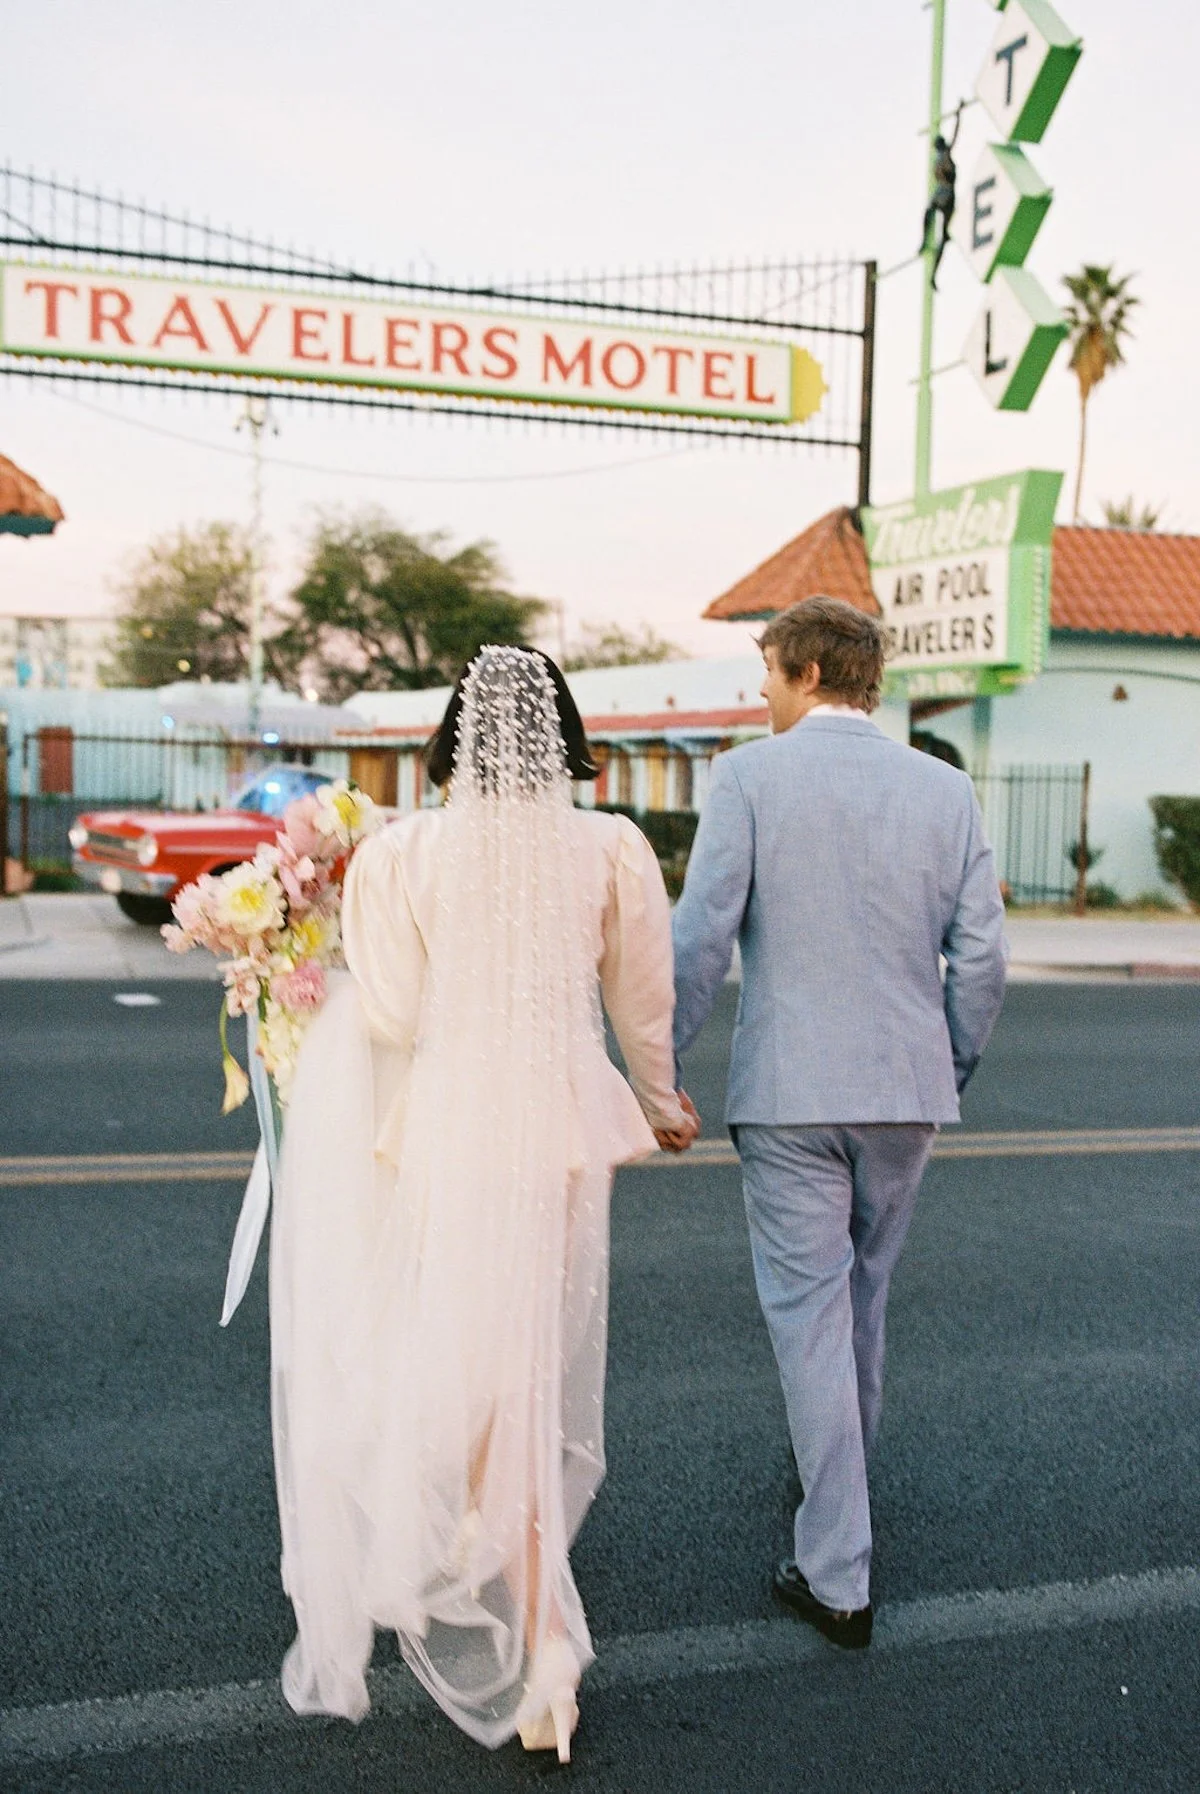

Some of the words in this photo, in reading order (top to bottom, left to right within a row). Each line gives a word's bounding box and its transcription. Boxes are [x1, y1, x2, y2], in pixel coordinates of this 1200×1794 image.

[24, 280, 518, 380] TRAVELERS
[540, 333, 775, 405] MOTEL
[937, 561, 991, 603] POOL
[886, 613, 994, 655] RAVELERS
